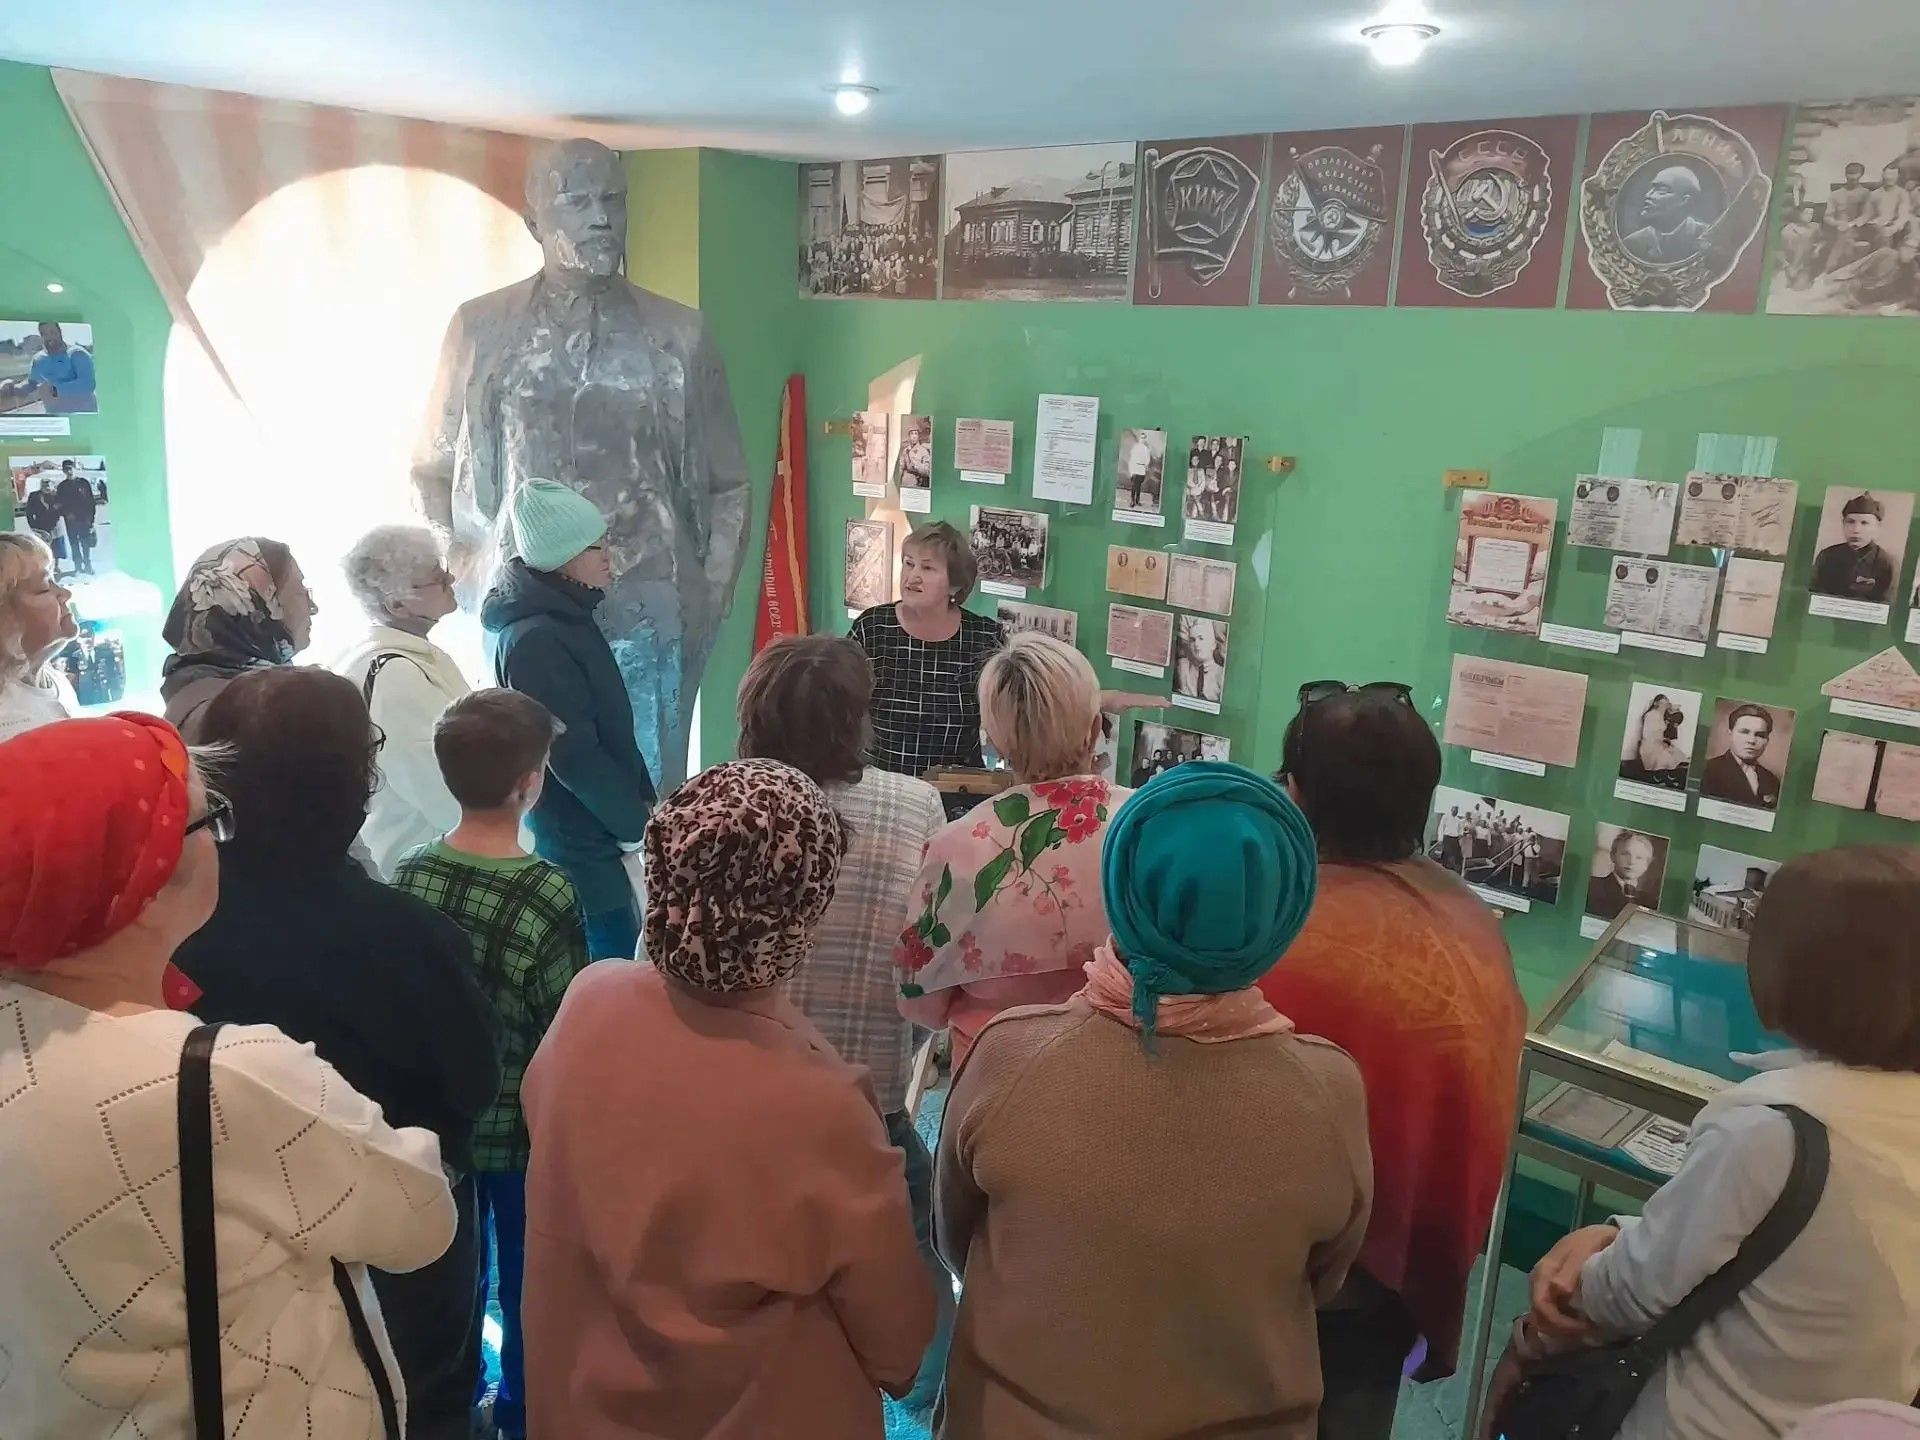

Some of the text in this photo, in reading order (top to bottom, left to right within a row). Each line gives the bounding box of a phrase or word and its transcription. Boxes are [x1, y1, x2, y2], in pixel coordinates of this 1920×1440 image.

[1458, 140, 1528, 163] СССР
[1671, 127, 1742, 168] ЛЕНИН
[1180, 184, 1225, 216] КИМ
